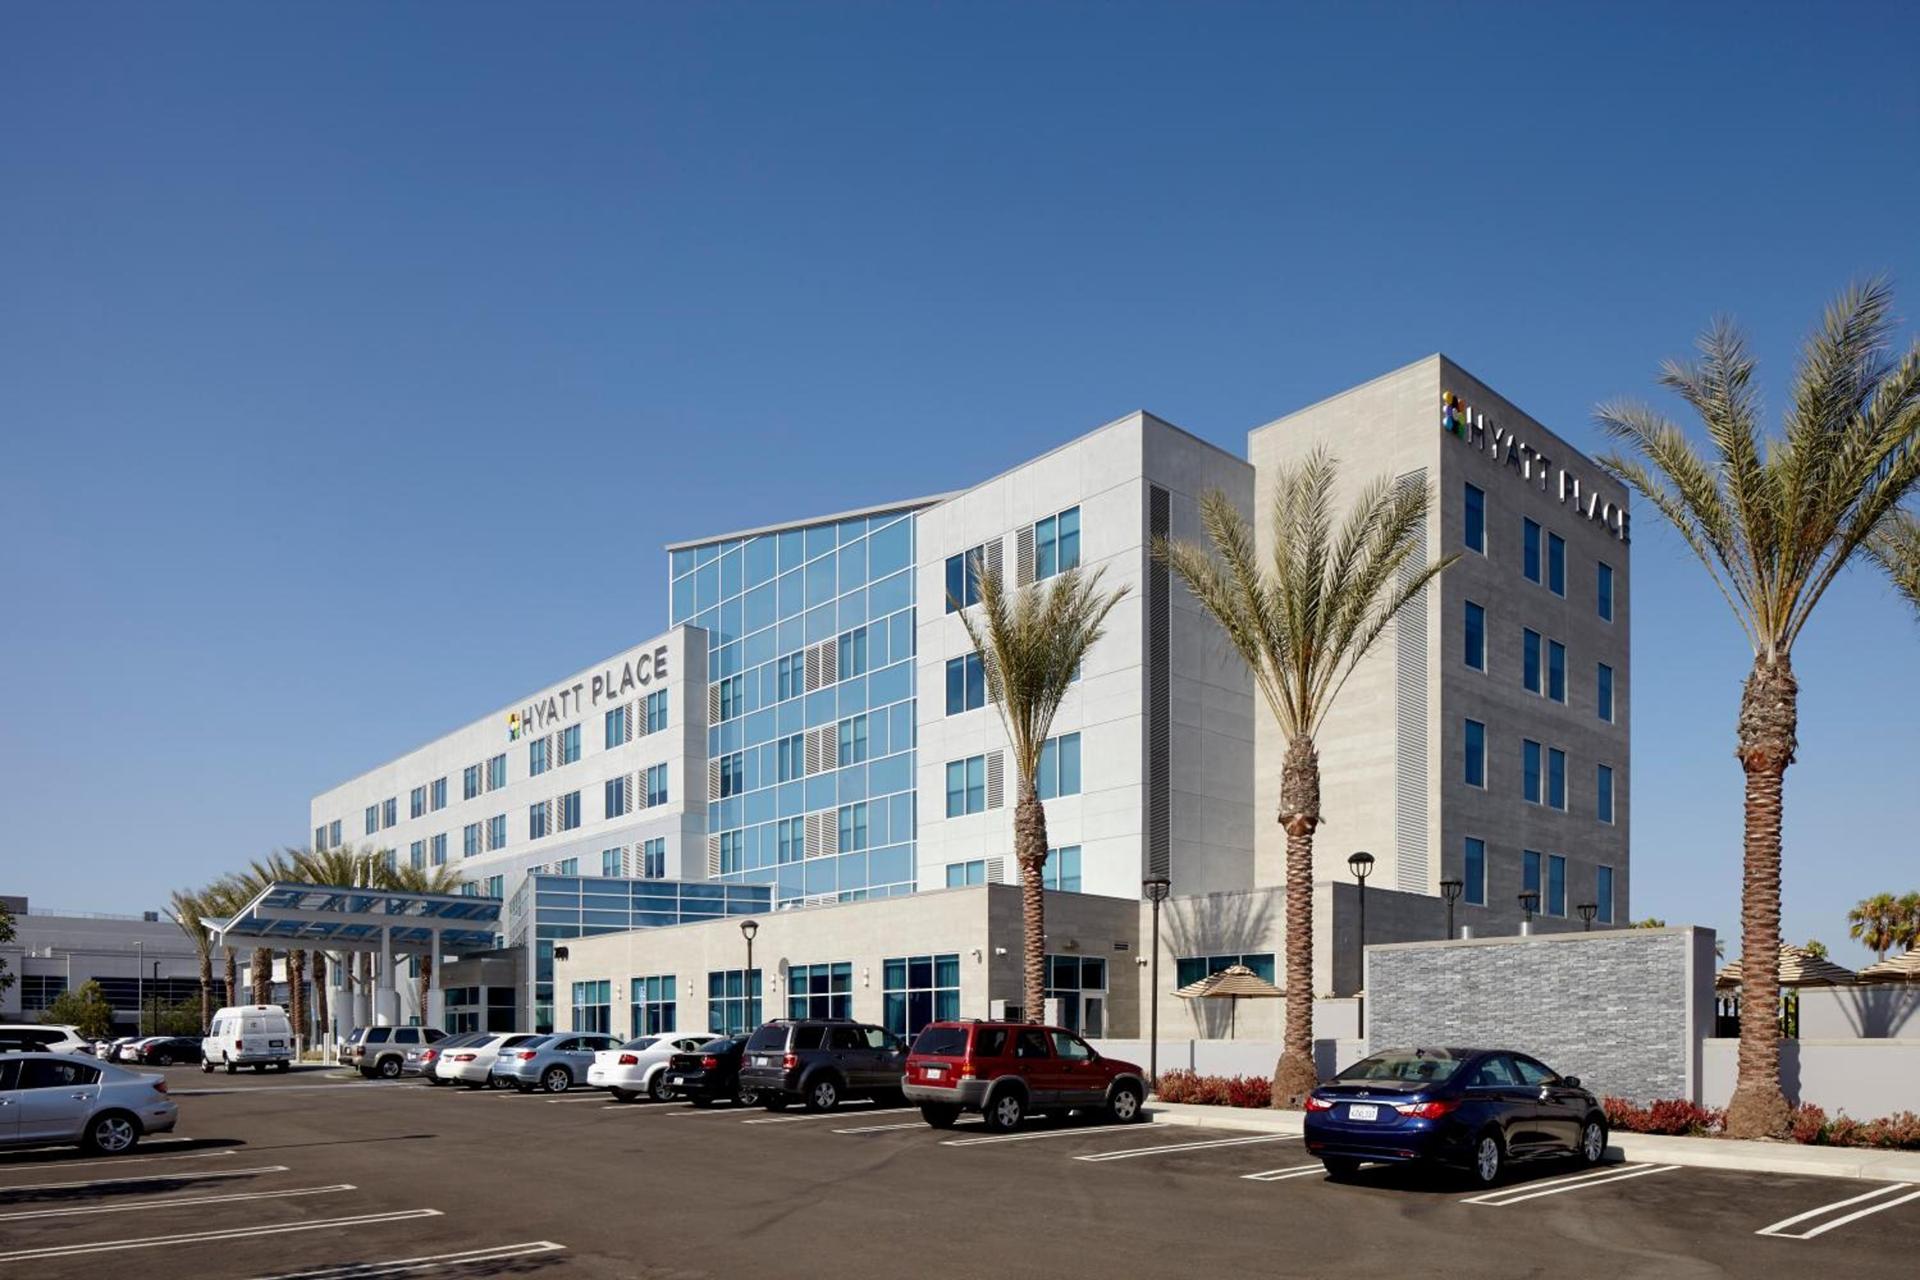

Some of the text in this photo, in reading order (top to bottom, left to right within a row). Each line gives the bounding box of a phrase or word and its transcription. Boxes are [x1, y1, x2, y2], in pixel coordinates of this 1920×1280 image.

[1466, 406, 1630, 544] HYATT PLACE
[521, 645, 668, 735] HYATT PLACE
